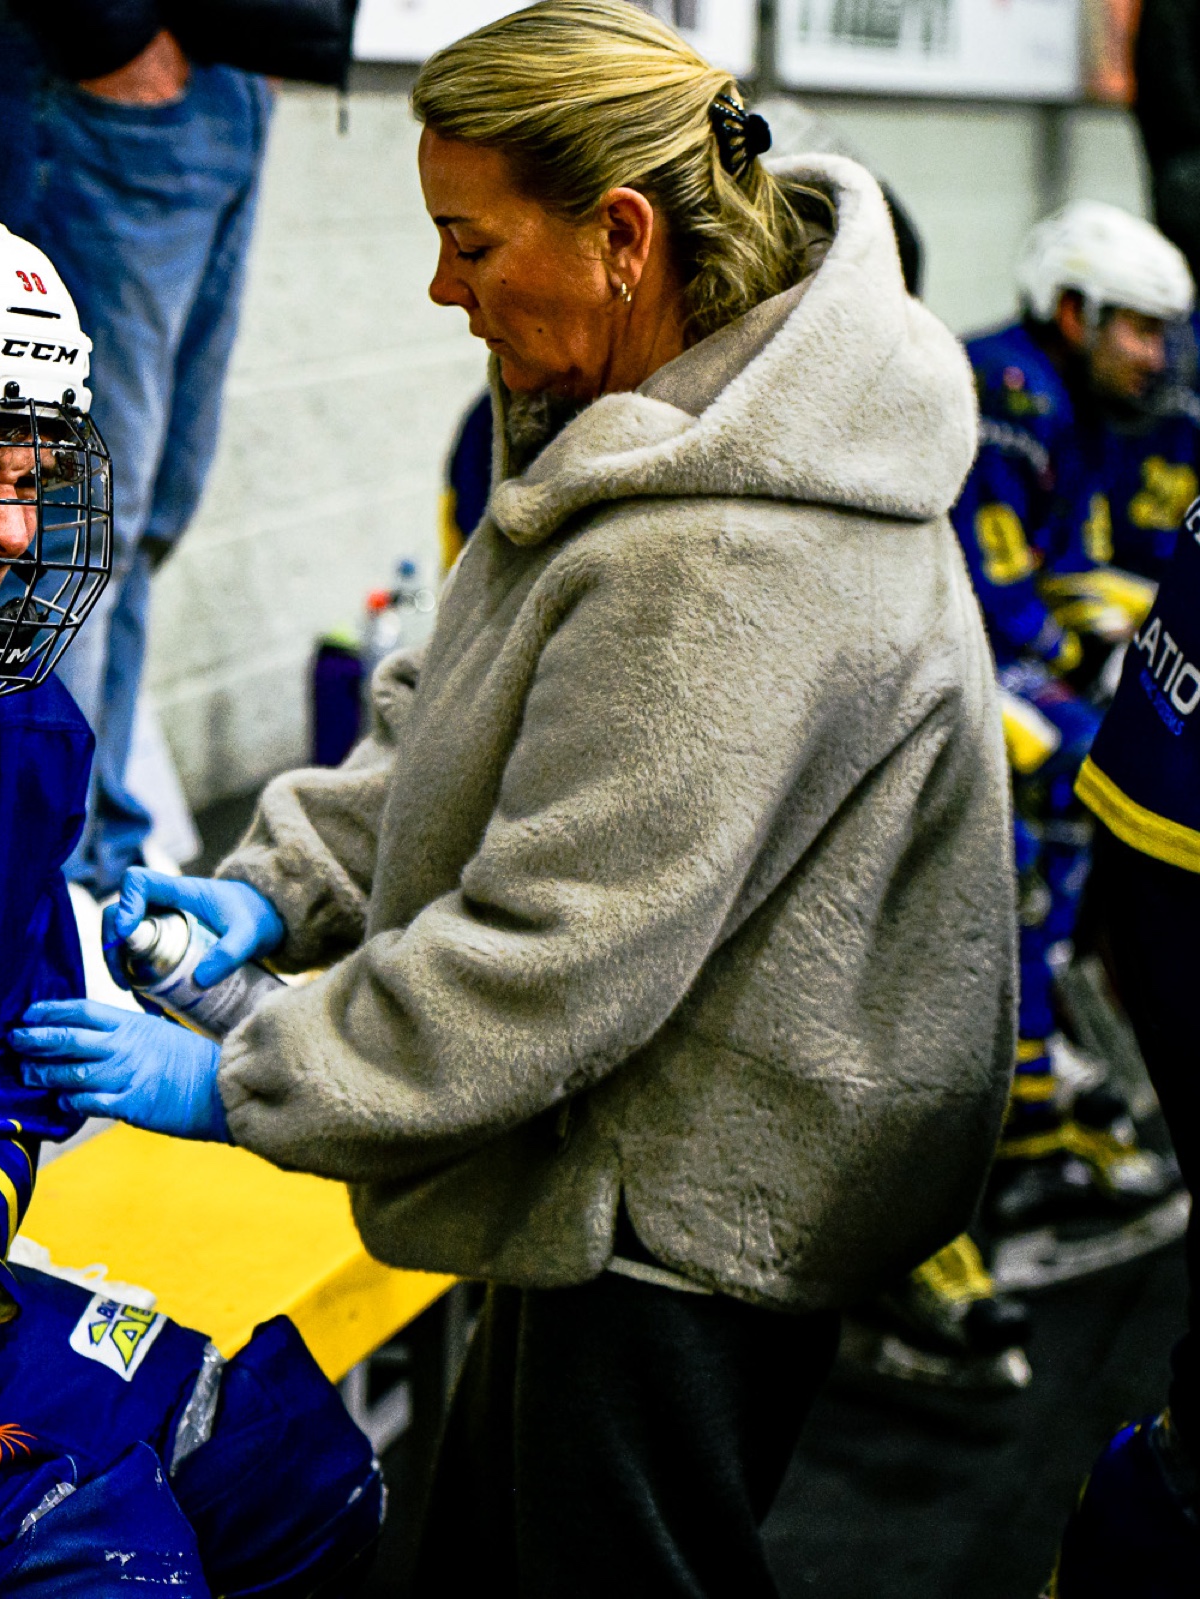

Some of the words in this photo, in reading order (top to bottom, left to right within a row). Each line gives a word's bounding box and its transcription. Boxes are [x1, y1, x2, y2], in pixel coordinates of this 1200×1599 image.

[15, 270, 48, 295] 30
[1, 338, 80, 366] CCM
[1133, 617, 1200, 715] ATIO
